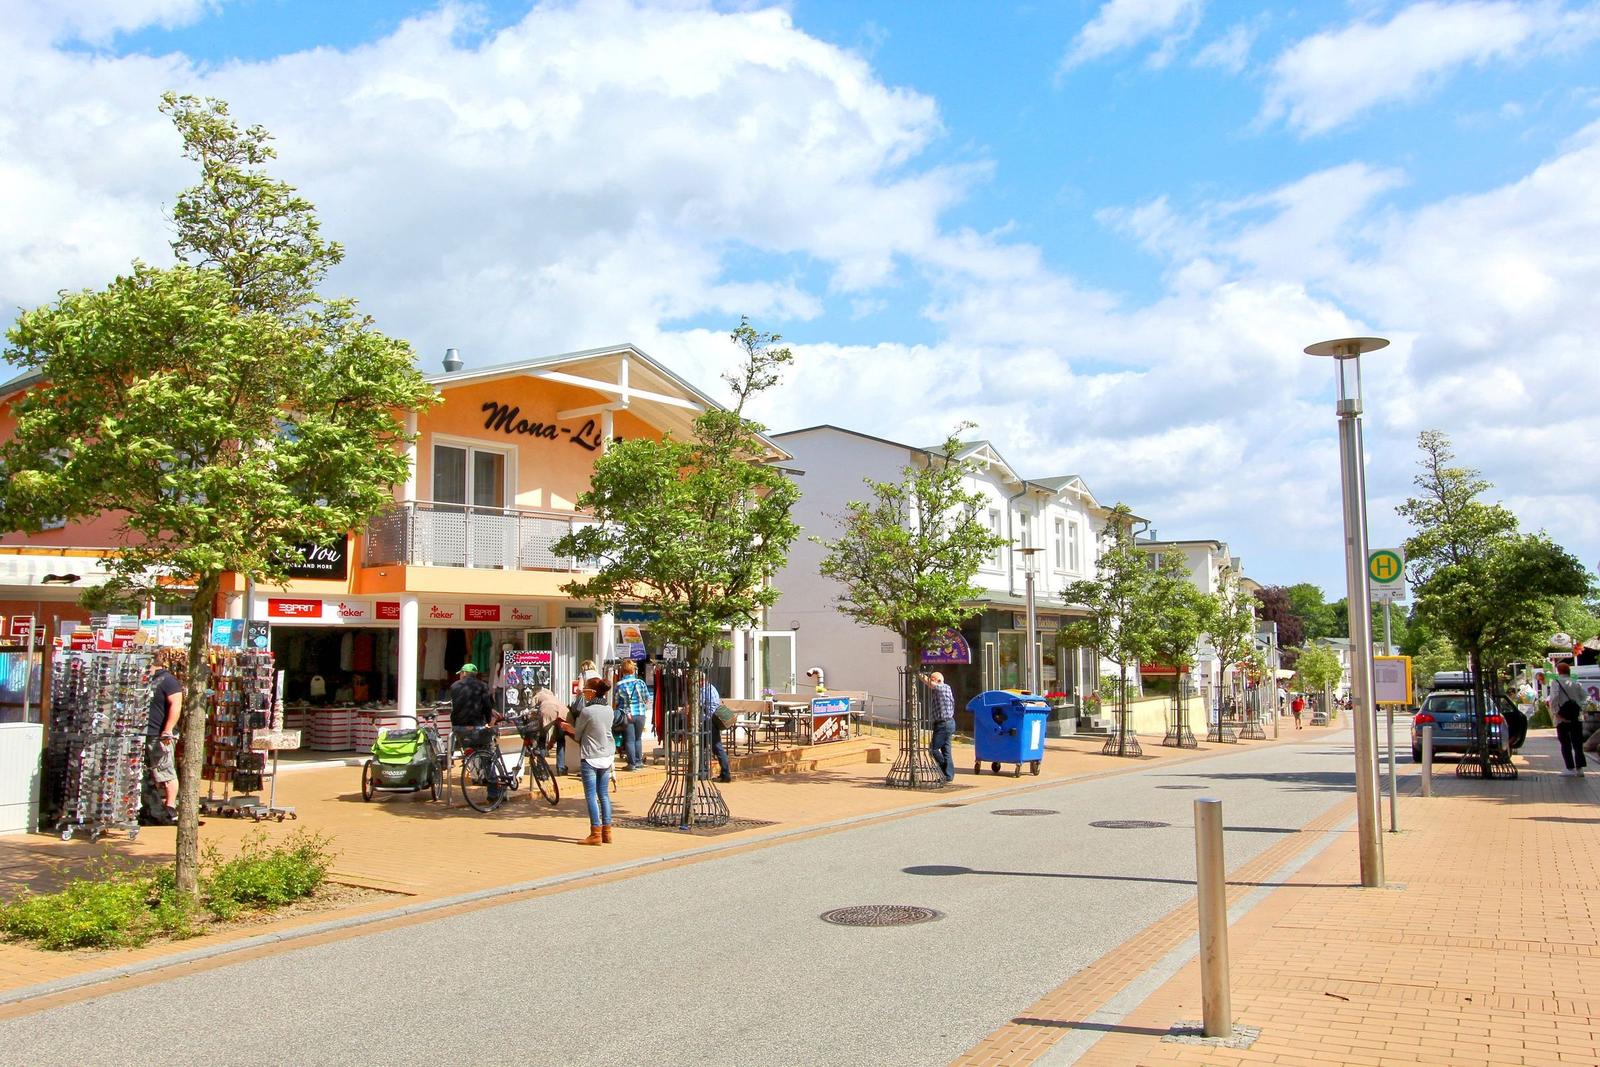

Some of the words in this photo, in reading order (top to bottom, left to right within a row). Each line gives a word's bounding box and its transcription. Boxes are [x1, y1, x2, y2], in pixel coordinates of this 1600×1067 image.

[309, 544, 341, 562] You
[1376, 557, 1392, 576] H
[279, 603, 316, 612] ESPRIT
[382, 606, 400, 614] ESP
[430, 607, 454, 619] rieker
[468, 608, 497, 616] ESPRIT
[511, 609, 533, 620] rieker
